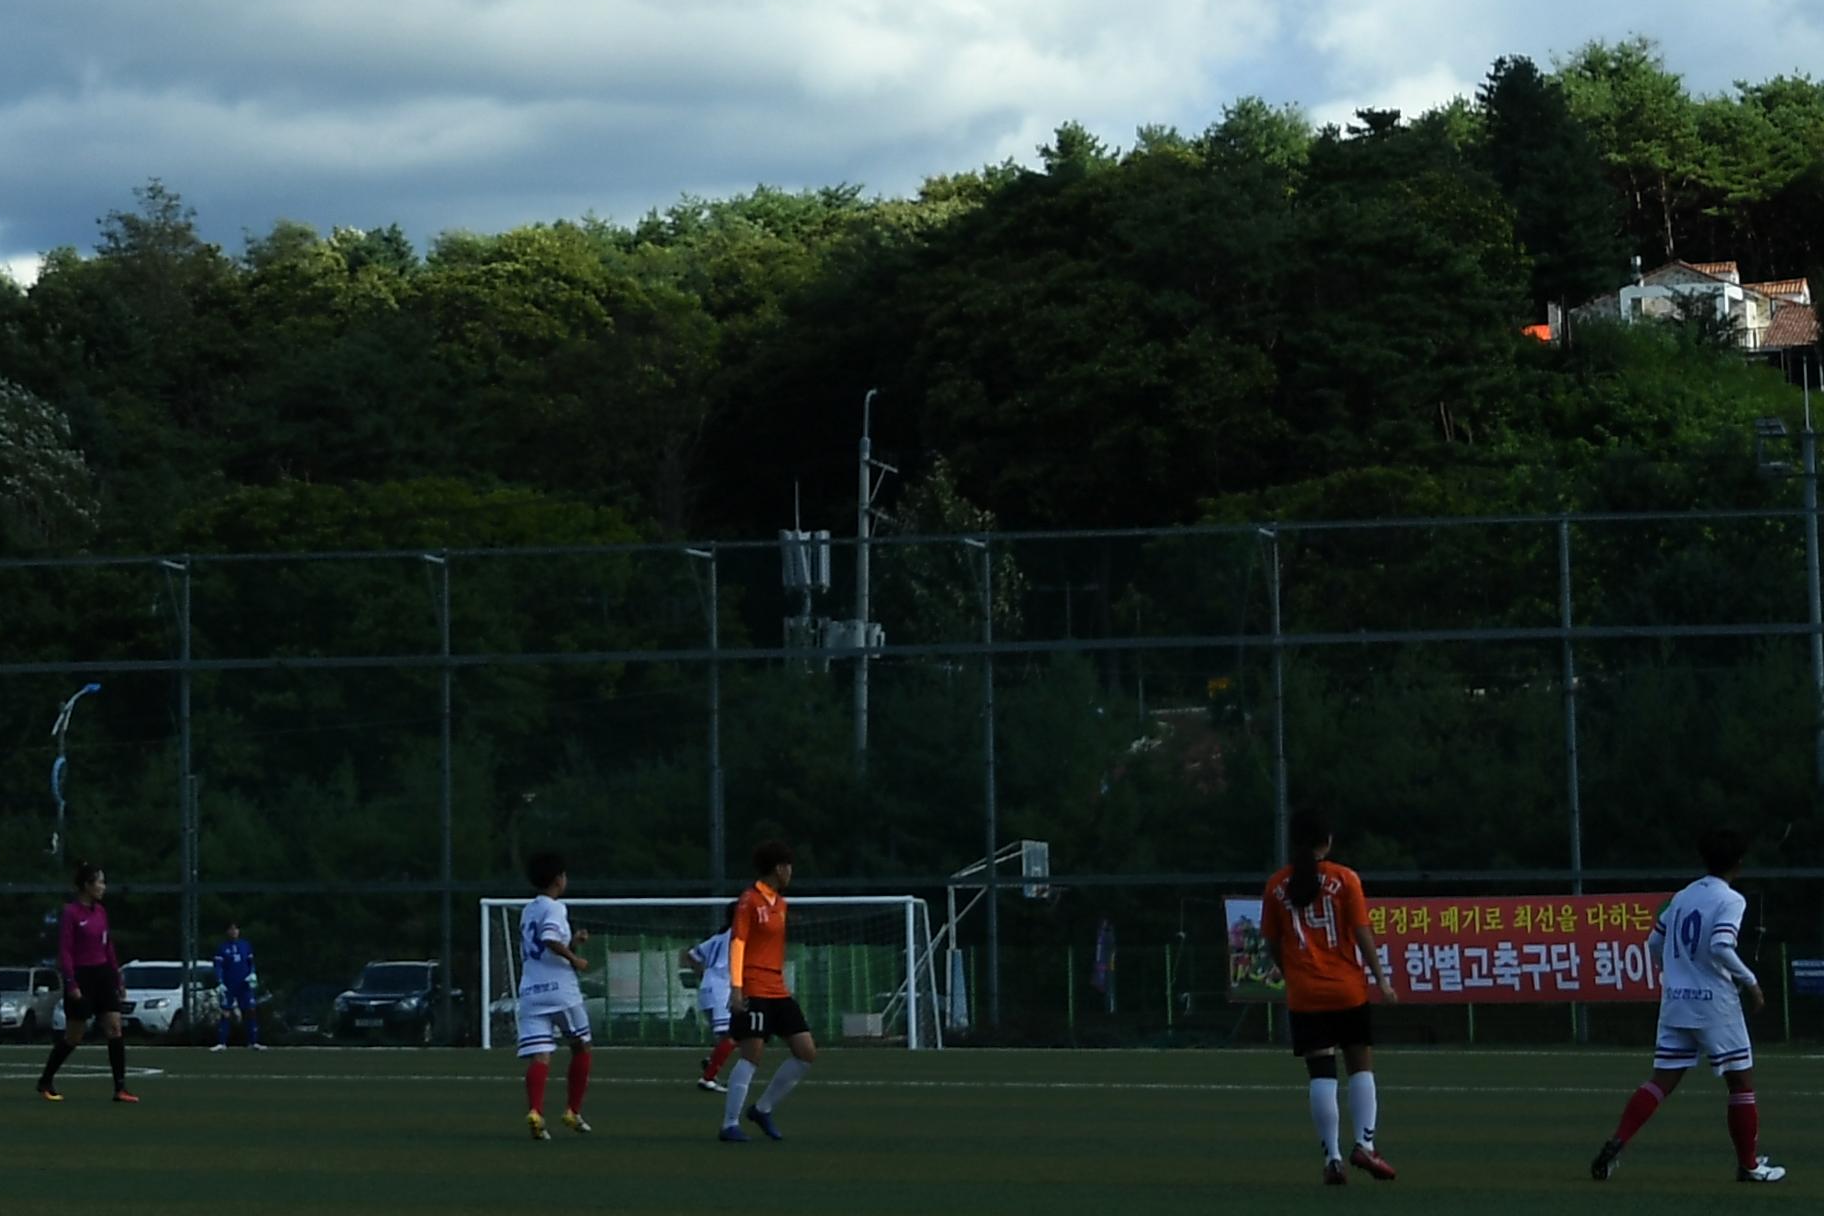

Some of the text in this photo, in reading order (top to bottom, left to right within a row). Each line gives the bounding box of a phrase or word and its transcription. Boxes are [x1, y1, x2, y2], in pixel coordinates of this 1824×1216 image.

[1286, 895, 1338, 950] 14
[1368, 902, 1652, 934] 열정과 패기로 최선을 다하는
[1404, 941, 1581, 992] 한별고축구단
[1593, 940, 1663, 991] 화이
[748, 1010, 765, 1031] 11
